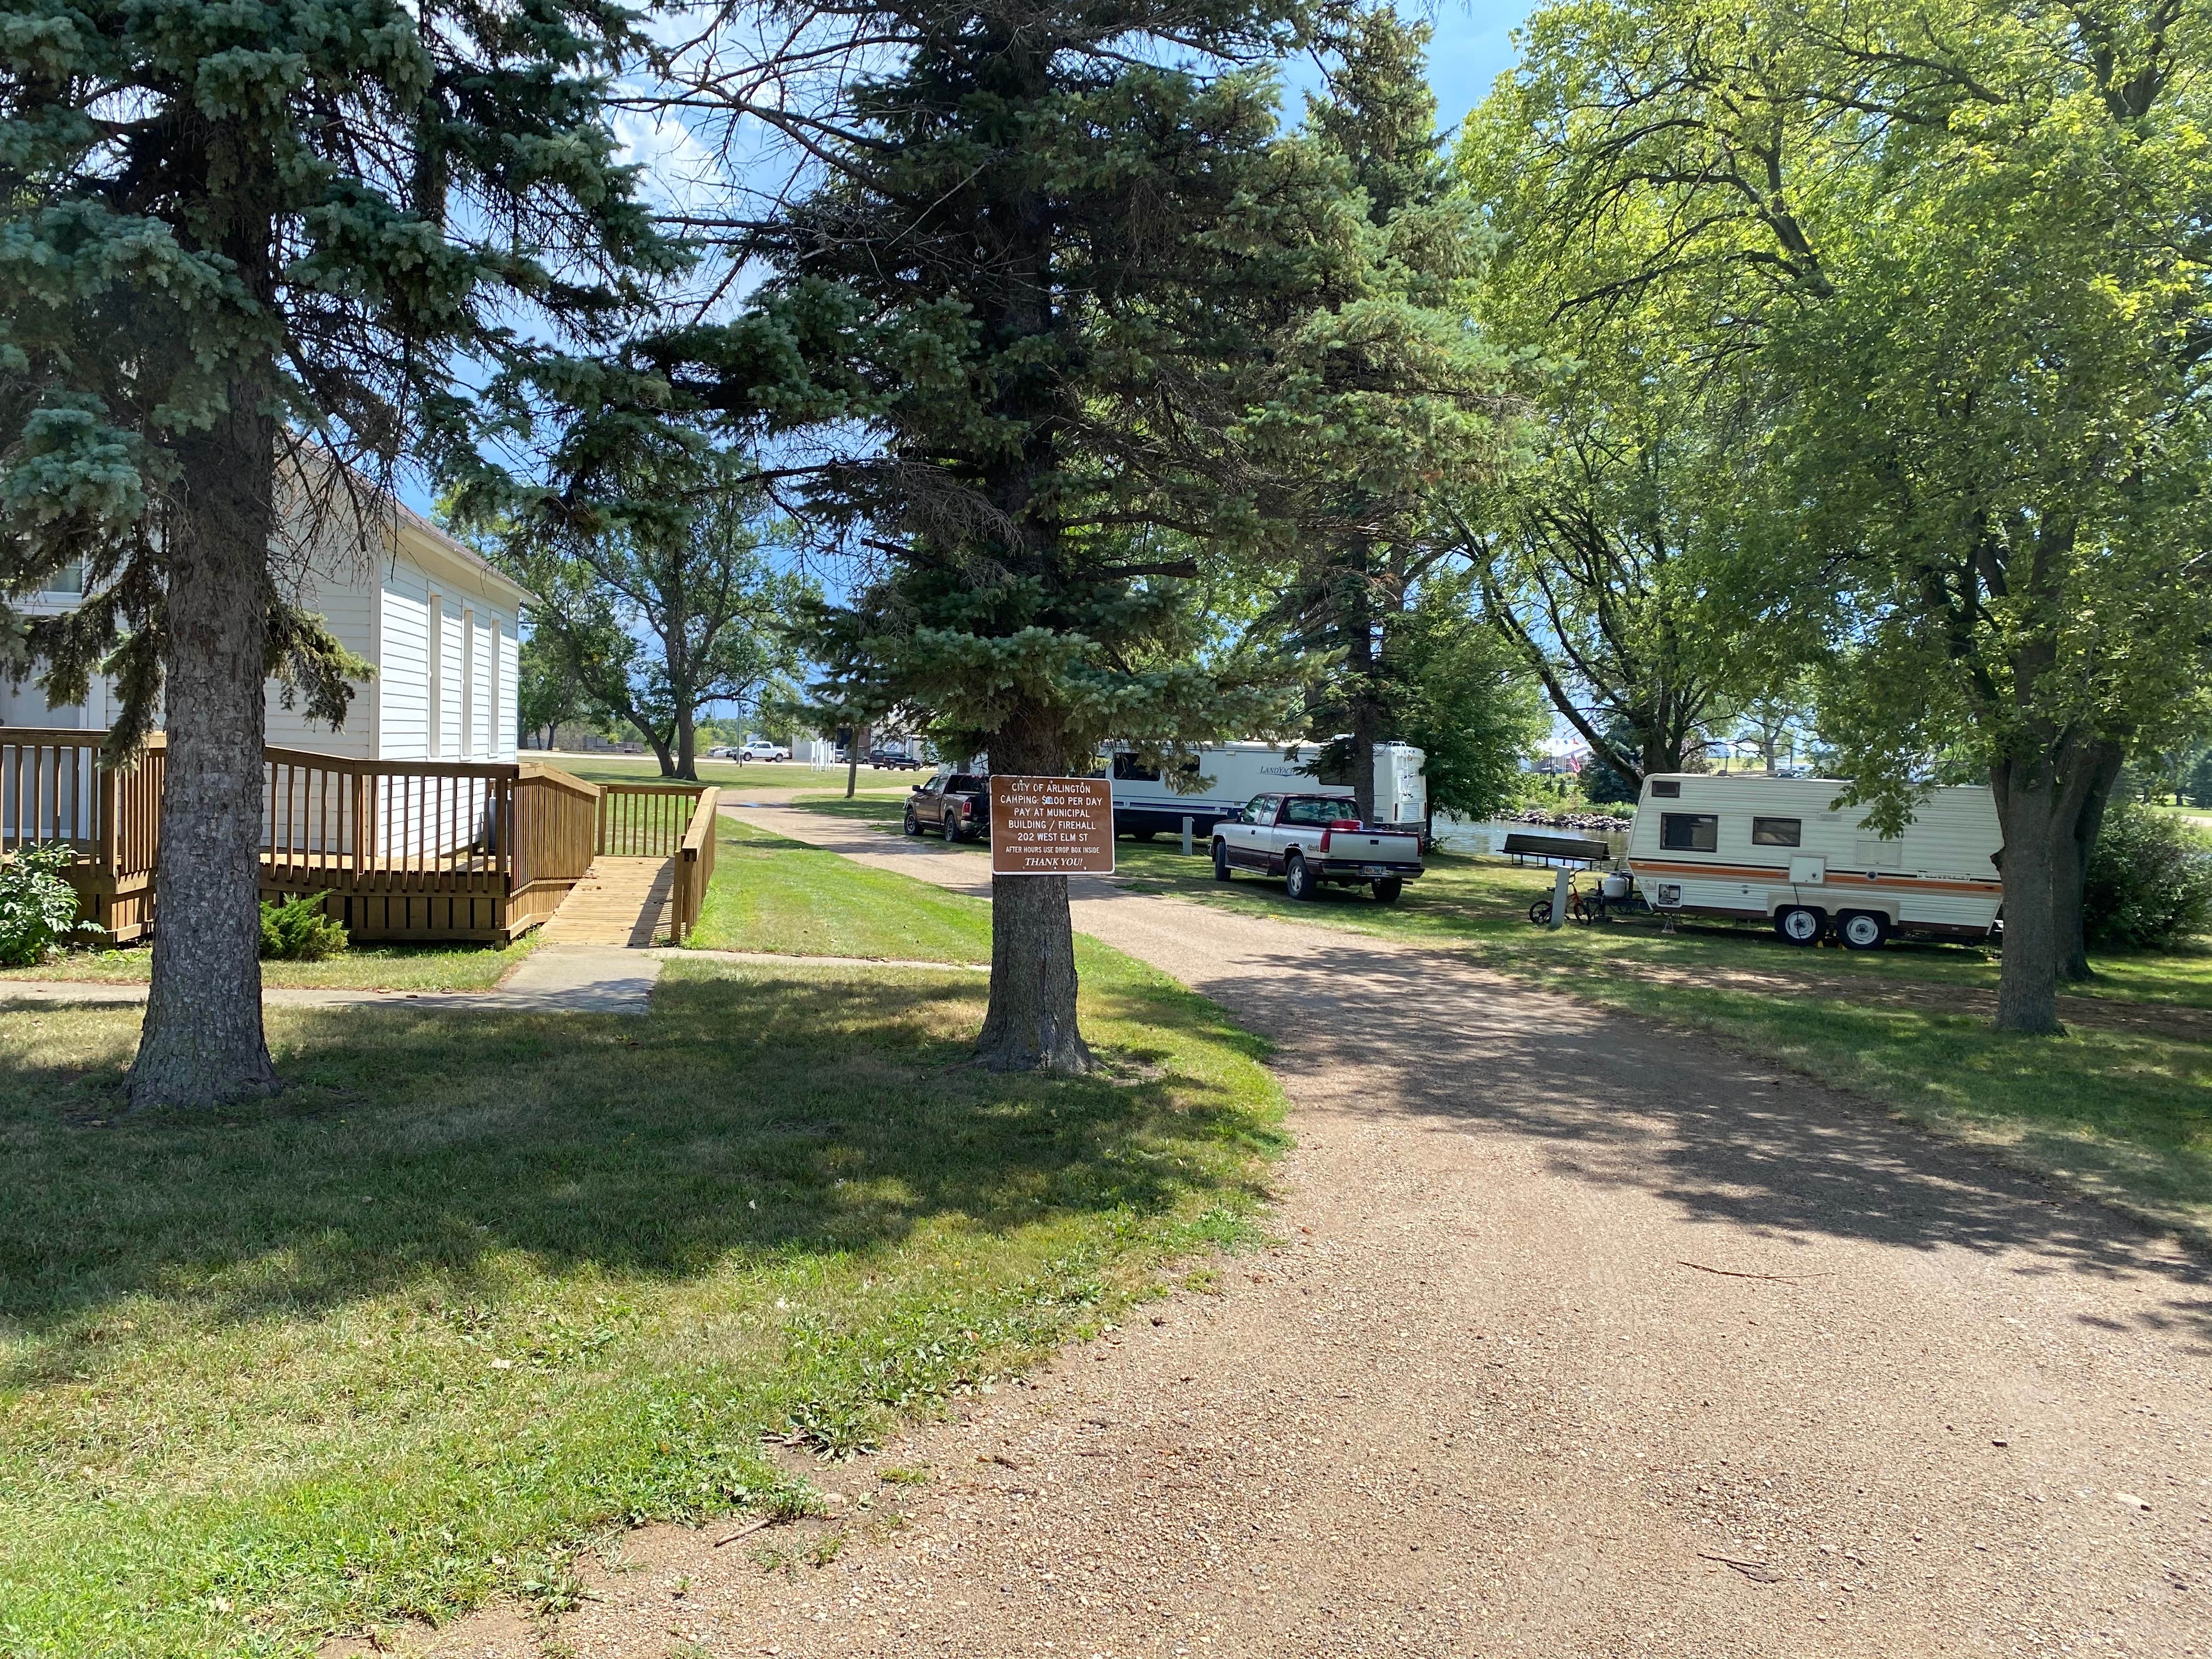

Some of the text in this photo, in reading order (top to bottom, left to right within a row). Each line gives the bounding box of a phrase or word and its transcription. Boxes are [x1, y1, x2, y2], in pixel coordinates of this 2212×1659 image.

[1047, 784, 1091, 793] ARLINGTON
[1001, 795, 1038, 804] CAMPING:
[1034, 808, 1043, 816] AT
[1047, 809, 1090, 817] MUNICIPAL
[1009, 820, 1096, 832] BUILDING / FIREHALL
[1037, 833, 1057, 841] WEST
[1025, 857, 1083, 866] THANK YOU!
